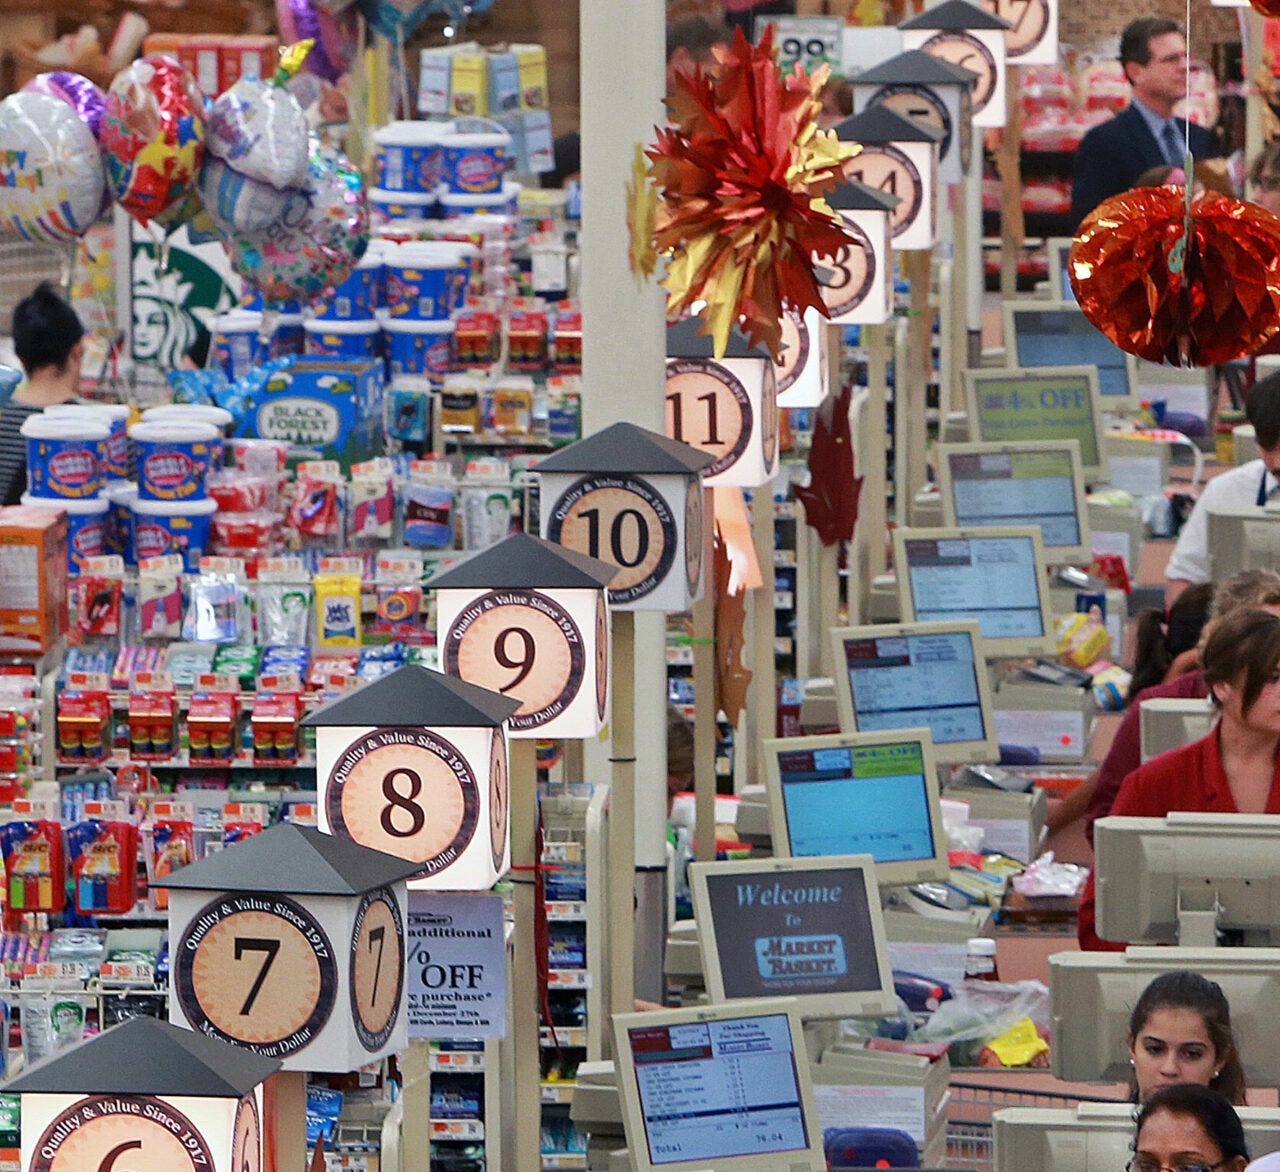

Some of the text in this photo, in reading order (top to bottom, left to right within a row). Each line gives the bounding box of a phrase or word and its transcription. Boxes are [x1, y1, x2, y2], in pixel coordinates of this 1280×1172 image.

[268, 417, 330, 431] FOREST
[273, 405, 324, 418] BLACK
[666, 392, 725, 446] 11
[555, 489, 584, 521] Quality
[593, 478, 624, 488] Value
[625, 481, 652, 501] Since
[578, 508, 649, 567] 10
[631, 577, 657, 596] Dollar
[453, 604, 484, 640] Quality
[496, 593, 528, 606] Value
[529, 597, 560, 620] Since
[558, 614, 578, 643] 1917
[493, 626, 535, 692] 9
[508, 701, 564, 728] Your Dollar
[334, 731, 472, 785] Quality & Value Since 1917
[380, 767, 425, 838] 8
[425, 848, 458, 872] Dollar
[736, 882, 843, 907] Welcome
[185, 898, 329, 959] Quality & Value Since 1917
[784, 912, 802, 927] To
[234, 936, 280, 1016] 7
[368, 925, 385, 1008] 7
[421, 964, 484, 989] OFF
[279, 1027, 313, 1053] Dollar
[41, 1099, 208, 1165] Quality & Value Since 1917
